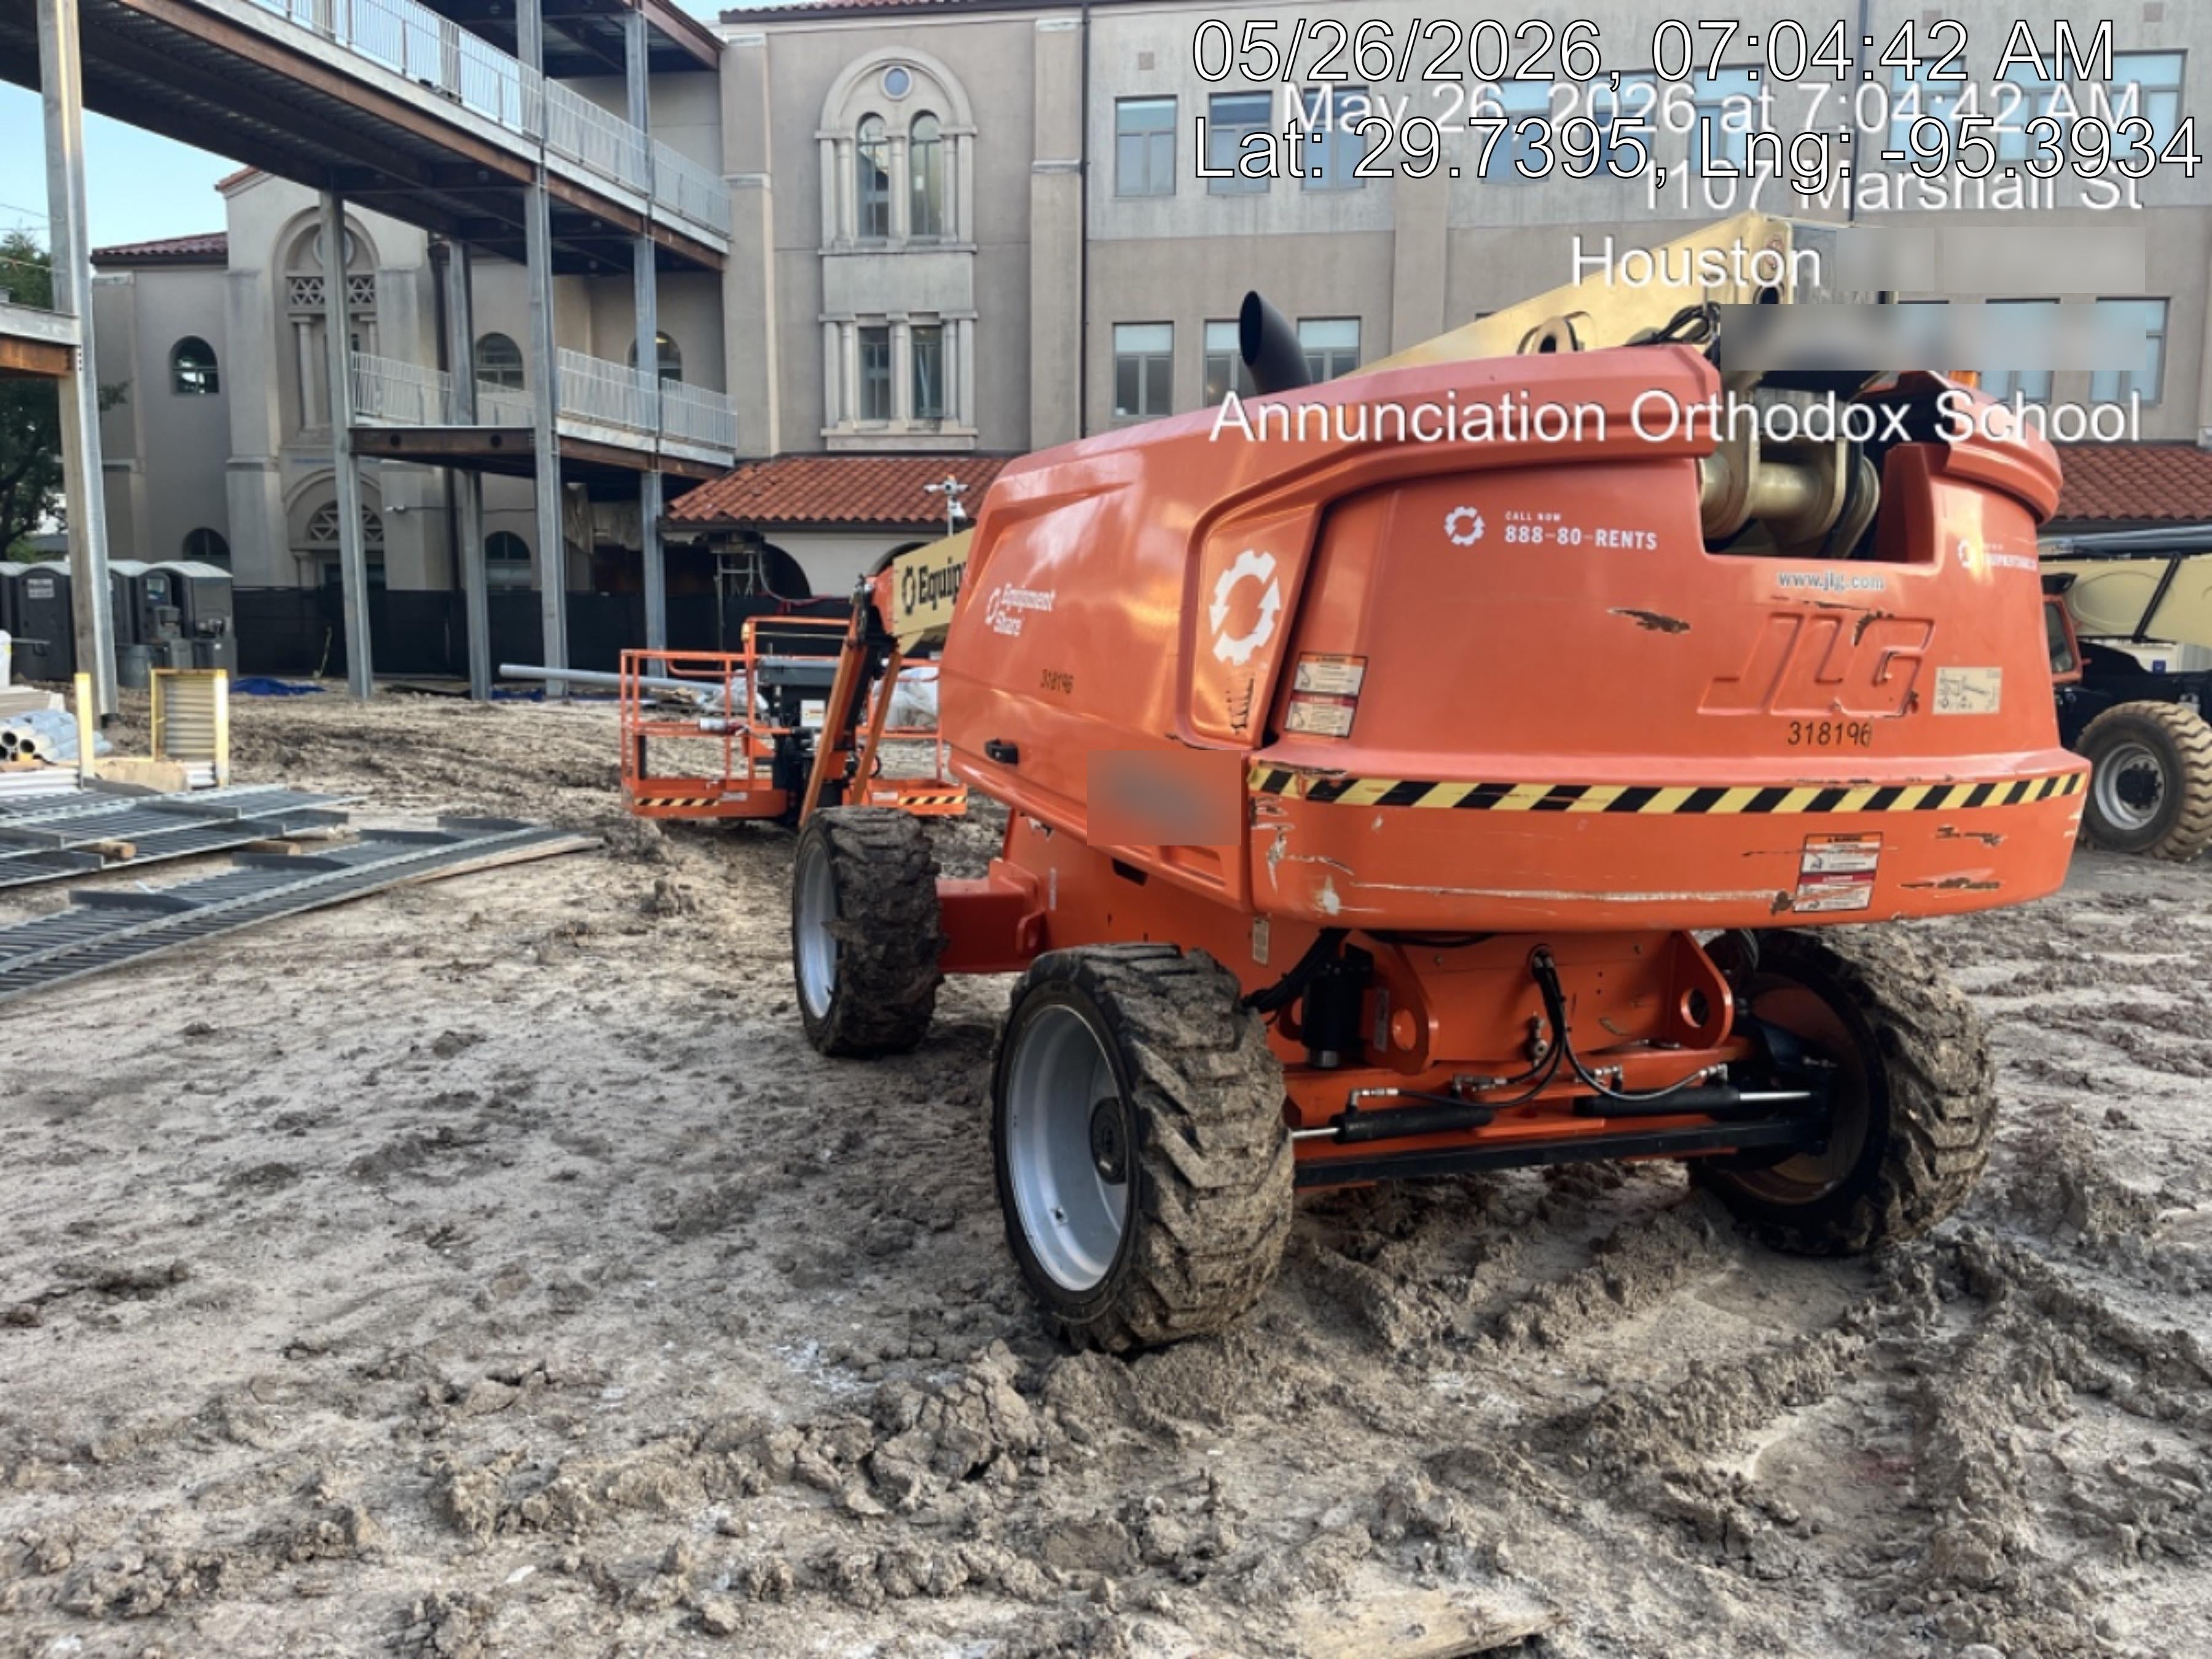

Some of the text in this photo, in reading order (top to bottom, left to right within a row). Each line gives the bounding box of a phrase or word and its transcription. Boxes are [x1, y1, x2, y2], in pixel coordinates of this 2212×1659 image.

[1505, 511, 1533, 521] CALL
[1504, 525, 1658, 551] 888-80-RENTS
[918, 555, 967, 611] Equip
[1778, 571, 1884, 590] www.jlg.com
[1696, 611, 1935, 718] JLG
[1787, 721, 1872, 748] 318196
